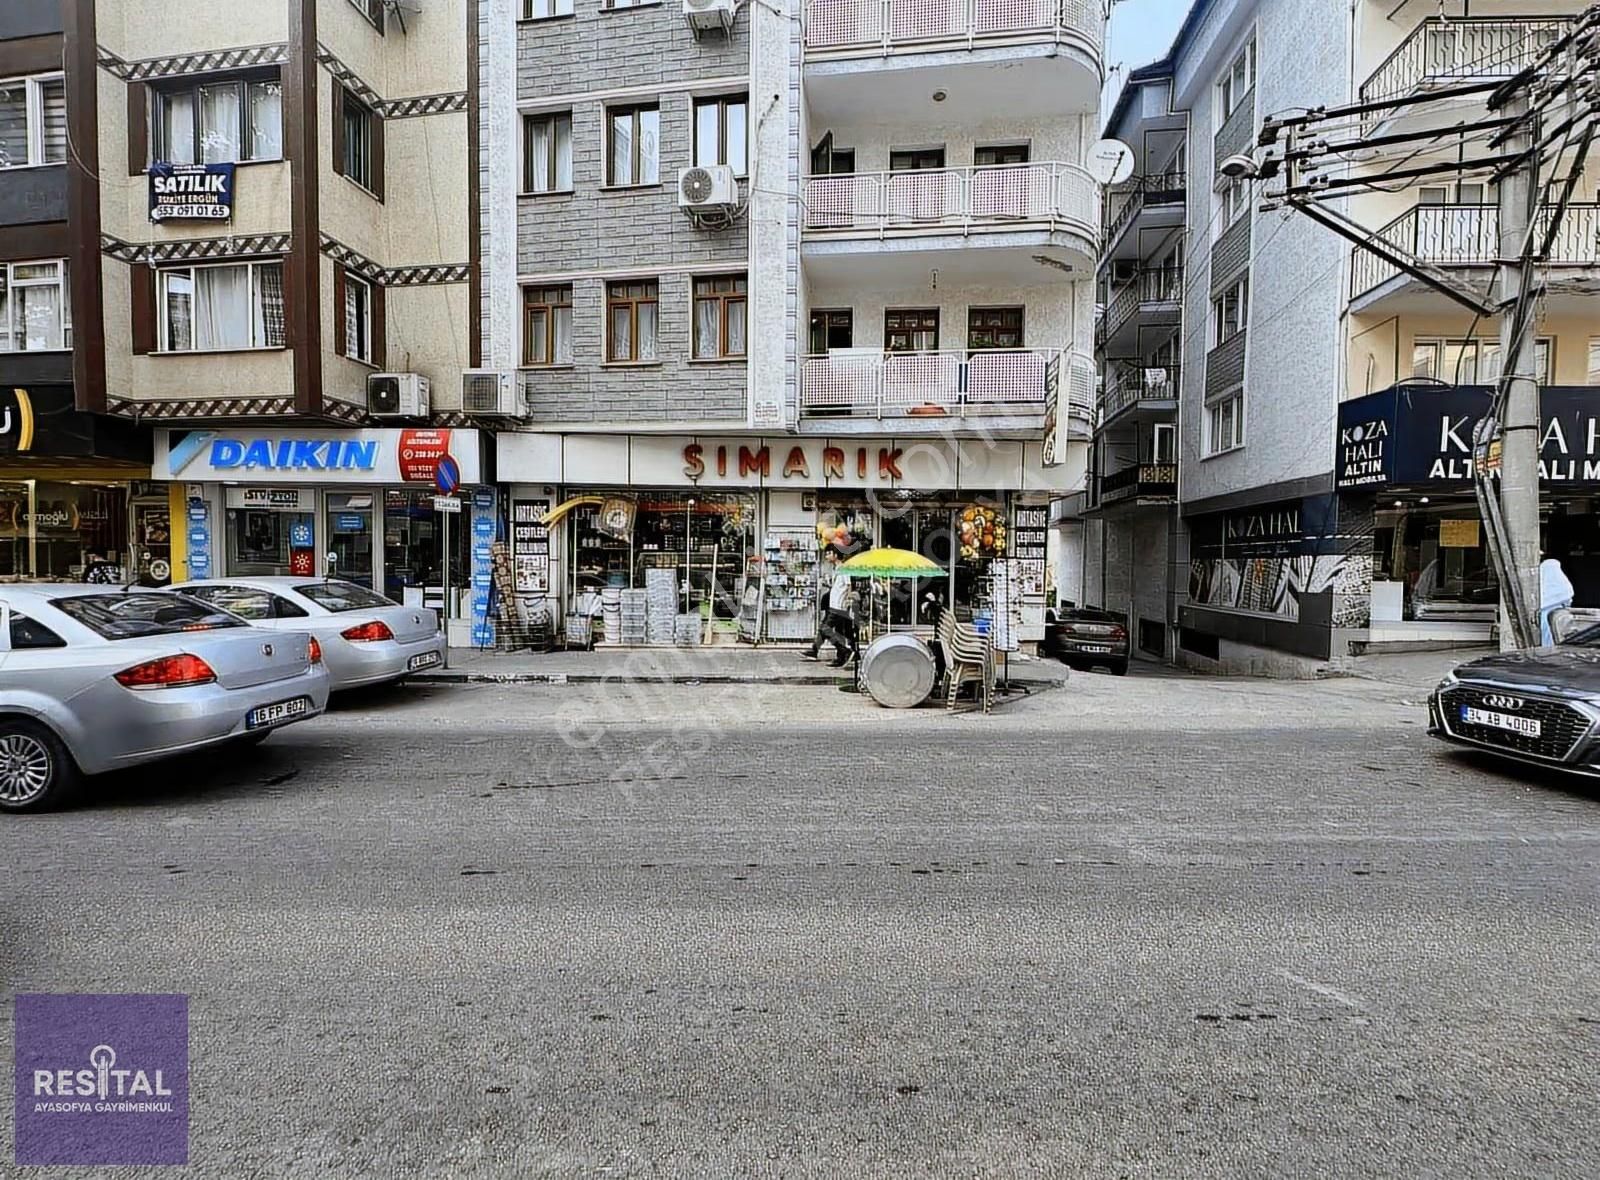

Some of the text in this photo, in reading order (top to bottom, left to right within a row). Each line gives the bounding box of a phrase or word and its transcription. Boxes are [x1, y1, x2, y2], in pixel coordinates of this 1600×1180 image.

[154, 175, 226, 193] SATILIK
[188, 193, 218, 204] ERGÜN
[177, 206, 194, 216] 091
[196, 206, 209, 216] 01
[211, 206, 225, 216] 65
[1342, 419, 1388, 445] KOZA
[1440, 415, 1569, 454] KA
[209, 438, 379, 469] DAIKIN
[683, 444, 903, 480] ŞIMARIK
[1345, 440, 1383, 463] HALI
[1344, 459, 1382, 477] ALTIN
[255, 709, 267, 722] 16
[268, 705, 284, 719] FP
[1468, 709, 1537, 734] 34 AB 4006
